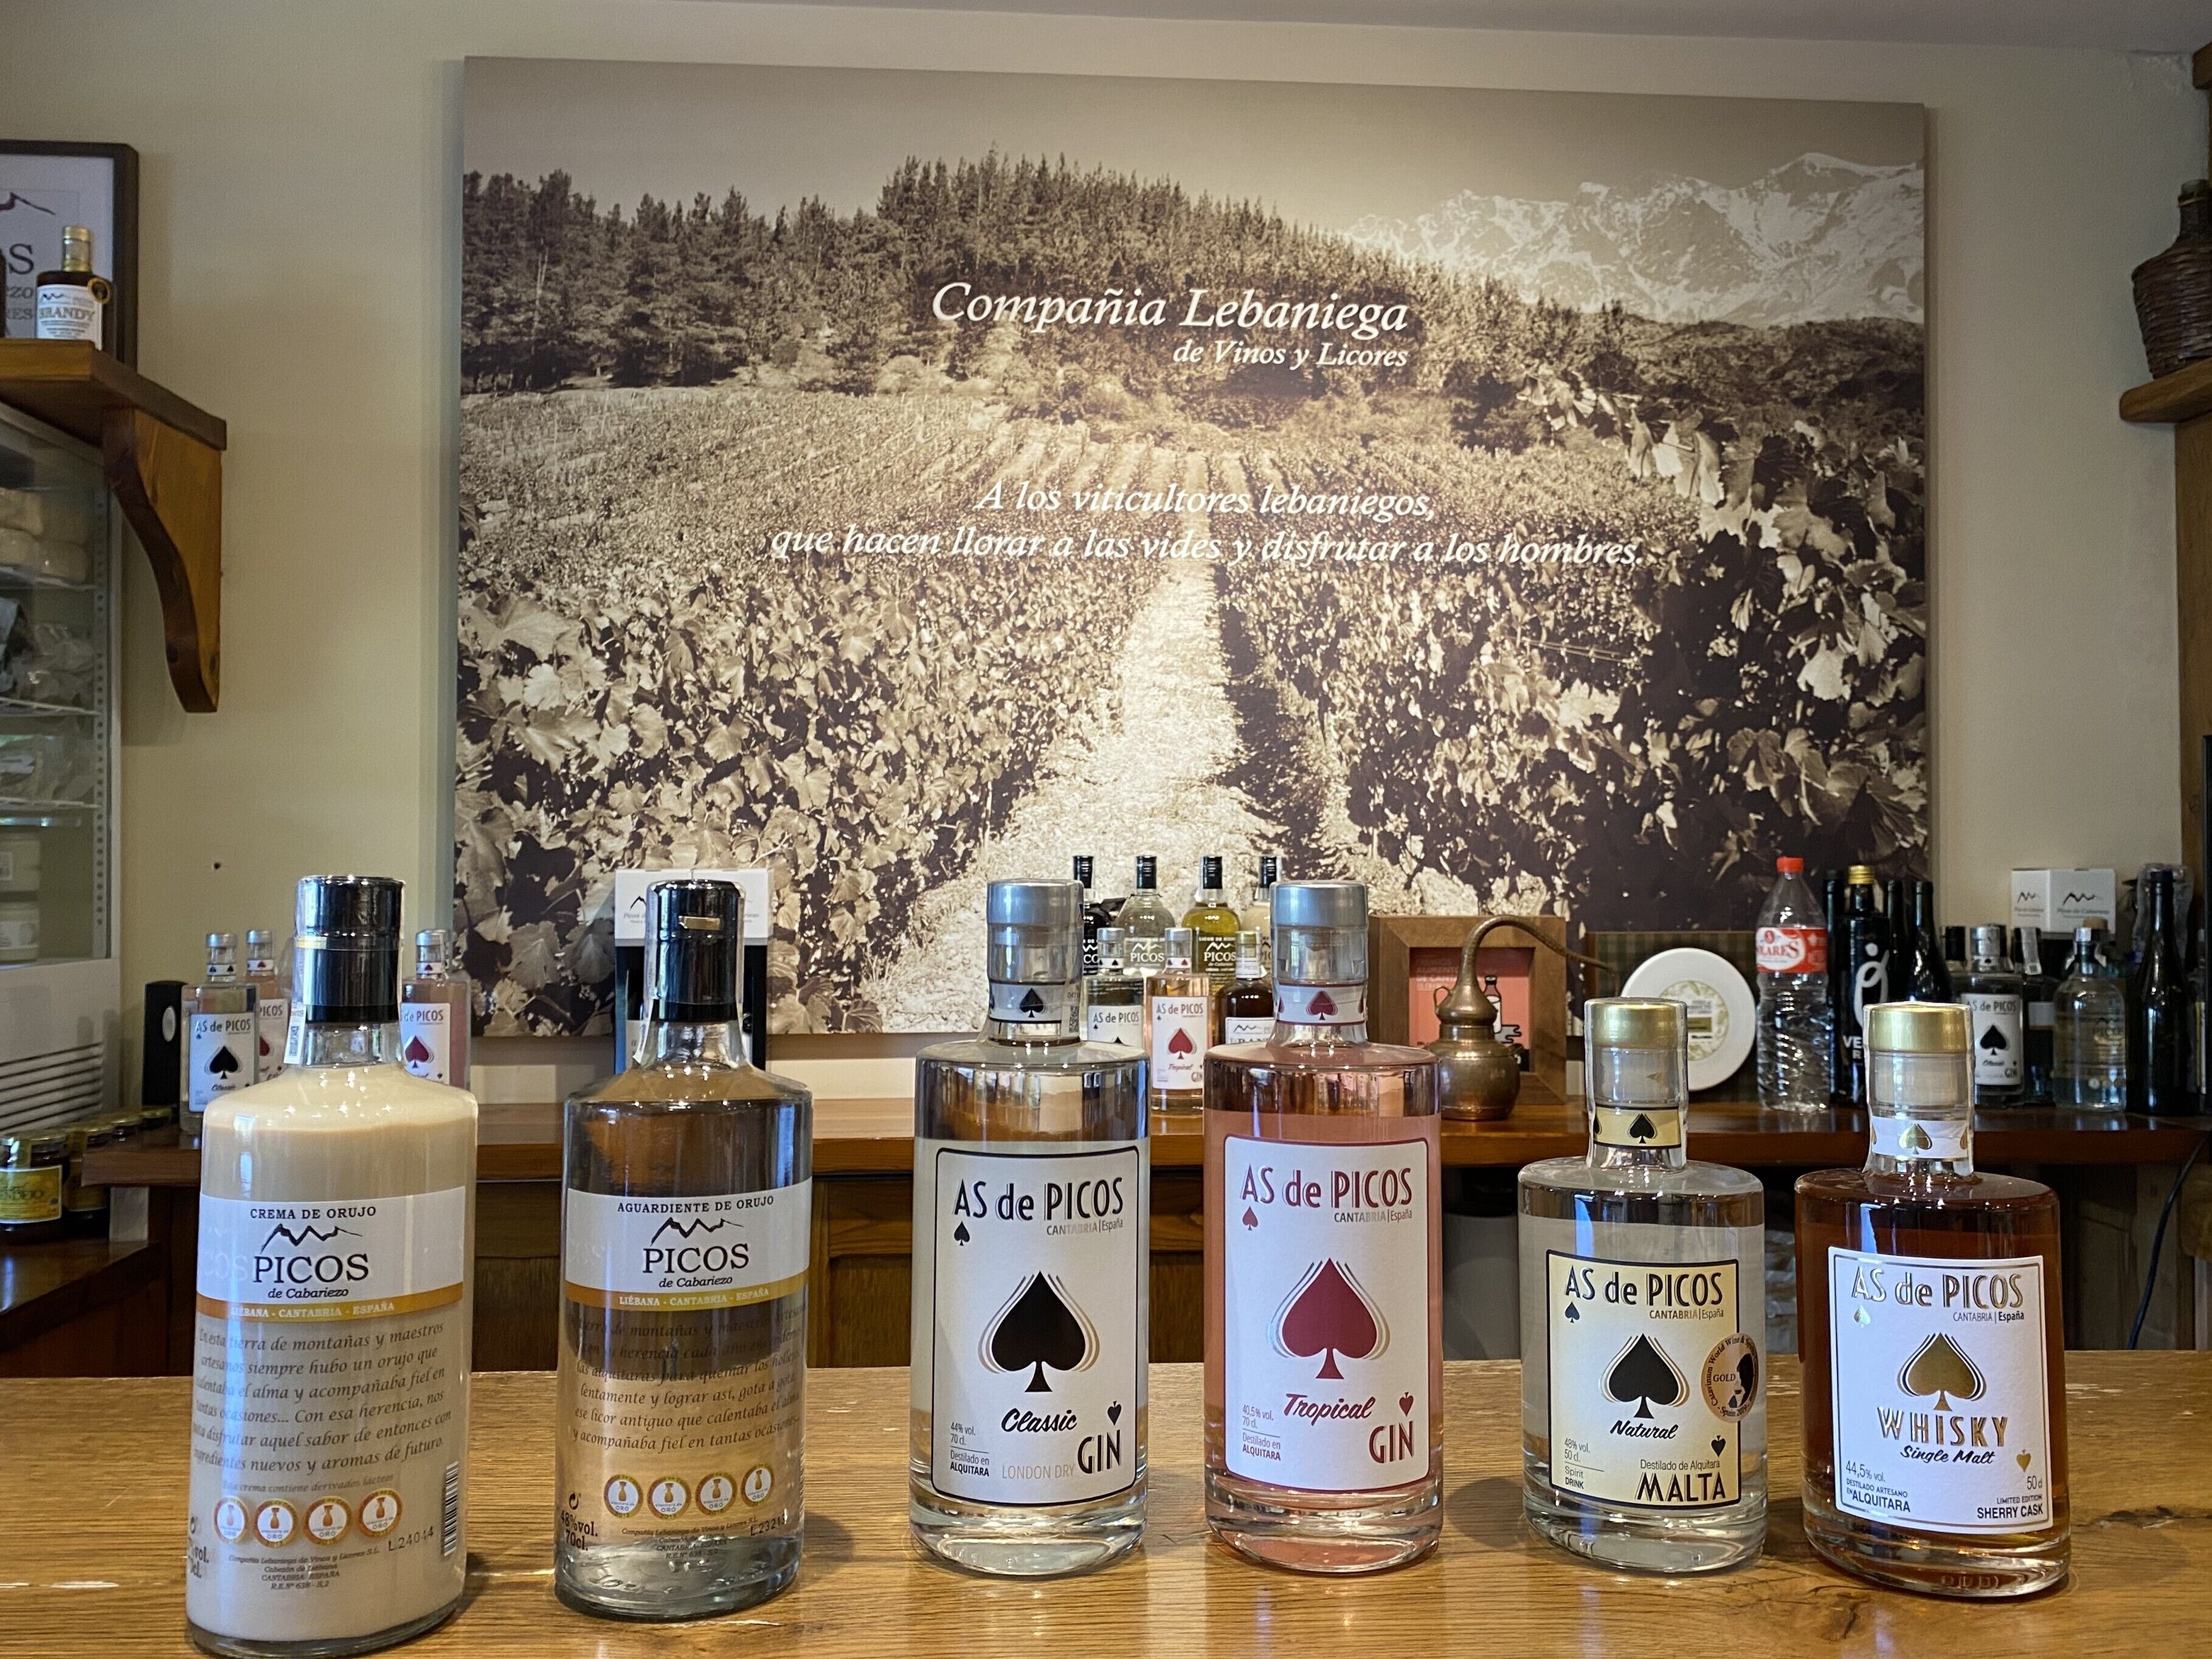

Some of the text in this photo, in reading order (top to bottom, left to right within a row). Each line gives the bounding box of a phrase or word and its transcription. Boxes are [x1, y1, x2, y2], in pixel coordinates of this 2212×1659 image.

[1180, 288, 1409, 341] Lebaniega
[1173, 339, 1408, 370] de Vinos y Licores
[973, 481, 1434, 523] A los viticultores lebaniegos,
[772, 524, 1643, 569] que hacen llorar a las vides y disfrutar a los hombres.
[1130, 953, 1164, 962] PICOS
[1204, 951, 1236, 961] PICOS
[1156, 1003, 1203, 1014] AS de PICOS
[1980, 1000, 2017, 1012] de PICOS
[404, 1010, 444, 1021] de PICOS
[1093, 1012, 1139, 1023] AS de PICOS
[195, 1019, 251, 1032] AS de PICOS
[1240, 1165, 1412, 1208] AS de PICOS
[618, 1196, 774, 1213] AGUARDIENTE DE ORUJO
[953, 1177, 1123, 1221] AS de PICOS
[250, 1207, 376, 1219] CREMA DE ORUJO
[643, 1243, 748, 1274] PICOS
[253, 1253, 369, 1283] PICOS
[659, 1275, 733, 1288] de Cabariezo
[1564, 1265, 1723, 1307] AS de PICOS
[1851, 1266, 2024, 1309] AS de PICOS
[268, 1286, 348, 1299] de Cabariezo
[620, 1289, 769, 1306] LIÉBANA CANTABRIA ESPAÑA
[278, 1307, 342, 1318] CANTABRIA
[352, 1303, 395, 1315] ESPAÑA
[1953, 1311, 2024, 1323] CANTABRIA España
[271, 1322, 444, 1351] de montañas y maestros
[1709, 1343, 1725, 1363] World
[247, 1347, 438, 1379] siempre hubo un orujo que
[252, 1368, 445, 1402] alma y acompañaba fiel en
[1713, 1373, 1736, 1383] GOLD
[664, 1391, 708, 1409] lograr
[620, 1404, 769, 1432] antiguo que calentaba
[1242, 1404, 1274, 1421] 40,5% vol.
[1284, 1393, 1376, 1426] Tropical
[951, 1421, 976, 1435] 44% vol.
[1001, 1408, 1077, 1433] Classic
[1242, 1415, 1250, 1426] 70
[1877, 1407, 2008, 1447] WHISKY
[1610, 1420, 1678, 1439] Natural
[950, 1433, 958, 1444] 70
[1243, 1432, 1281, 1450] Destilado en
[1369, 1421, 1414, 1463] GIN
[1564, 1438, 1591, 1453] 48% vol.
[950, 1450, 989, 1466] Destilado en
[1077, 1429, 1122, 1474] GIN
[1242, 1444, 1281, 1461] ALQUITARA
[1564, 1449, 1572, 1460] 50
[1900, 1445, 1996, 1464] Single Malt
[950, 1463, 989, 1477] ALQUITARA
[1002, 1464, 1075, 1479] LONDON DRY
[1565, 1466, 1583, 1479] Spirit
[1640, 1459, 1720, 1471] Destilado de Alquitara
[1845, 1460, 1885, 1483] 44,5% vol.
[1565, 1477, 1584, 1490] DRINK
[1634, 1472, 1726, 1502] MALTA
[1847, 1478, 1908, 1498] DESTILADO ARTESANO
[2027, 1476, 2037, 1490] 50
[1852, 1490, 1910, 1513] ALQUITARA
[1997, 1494, 2042, 1505] LIMITED EDITION
[1977, 1505, 2043, 1519] SHERRY CASK
